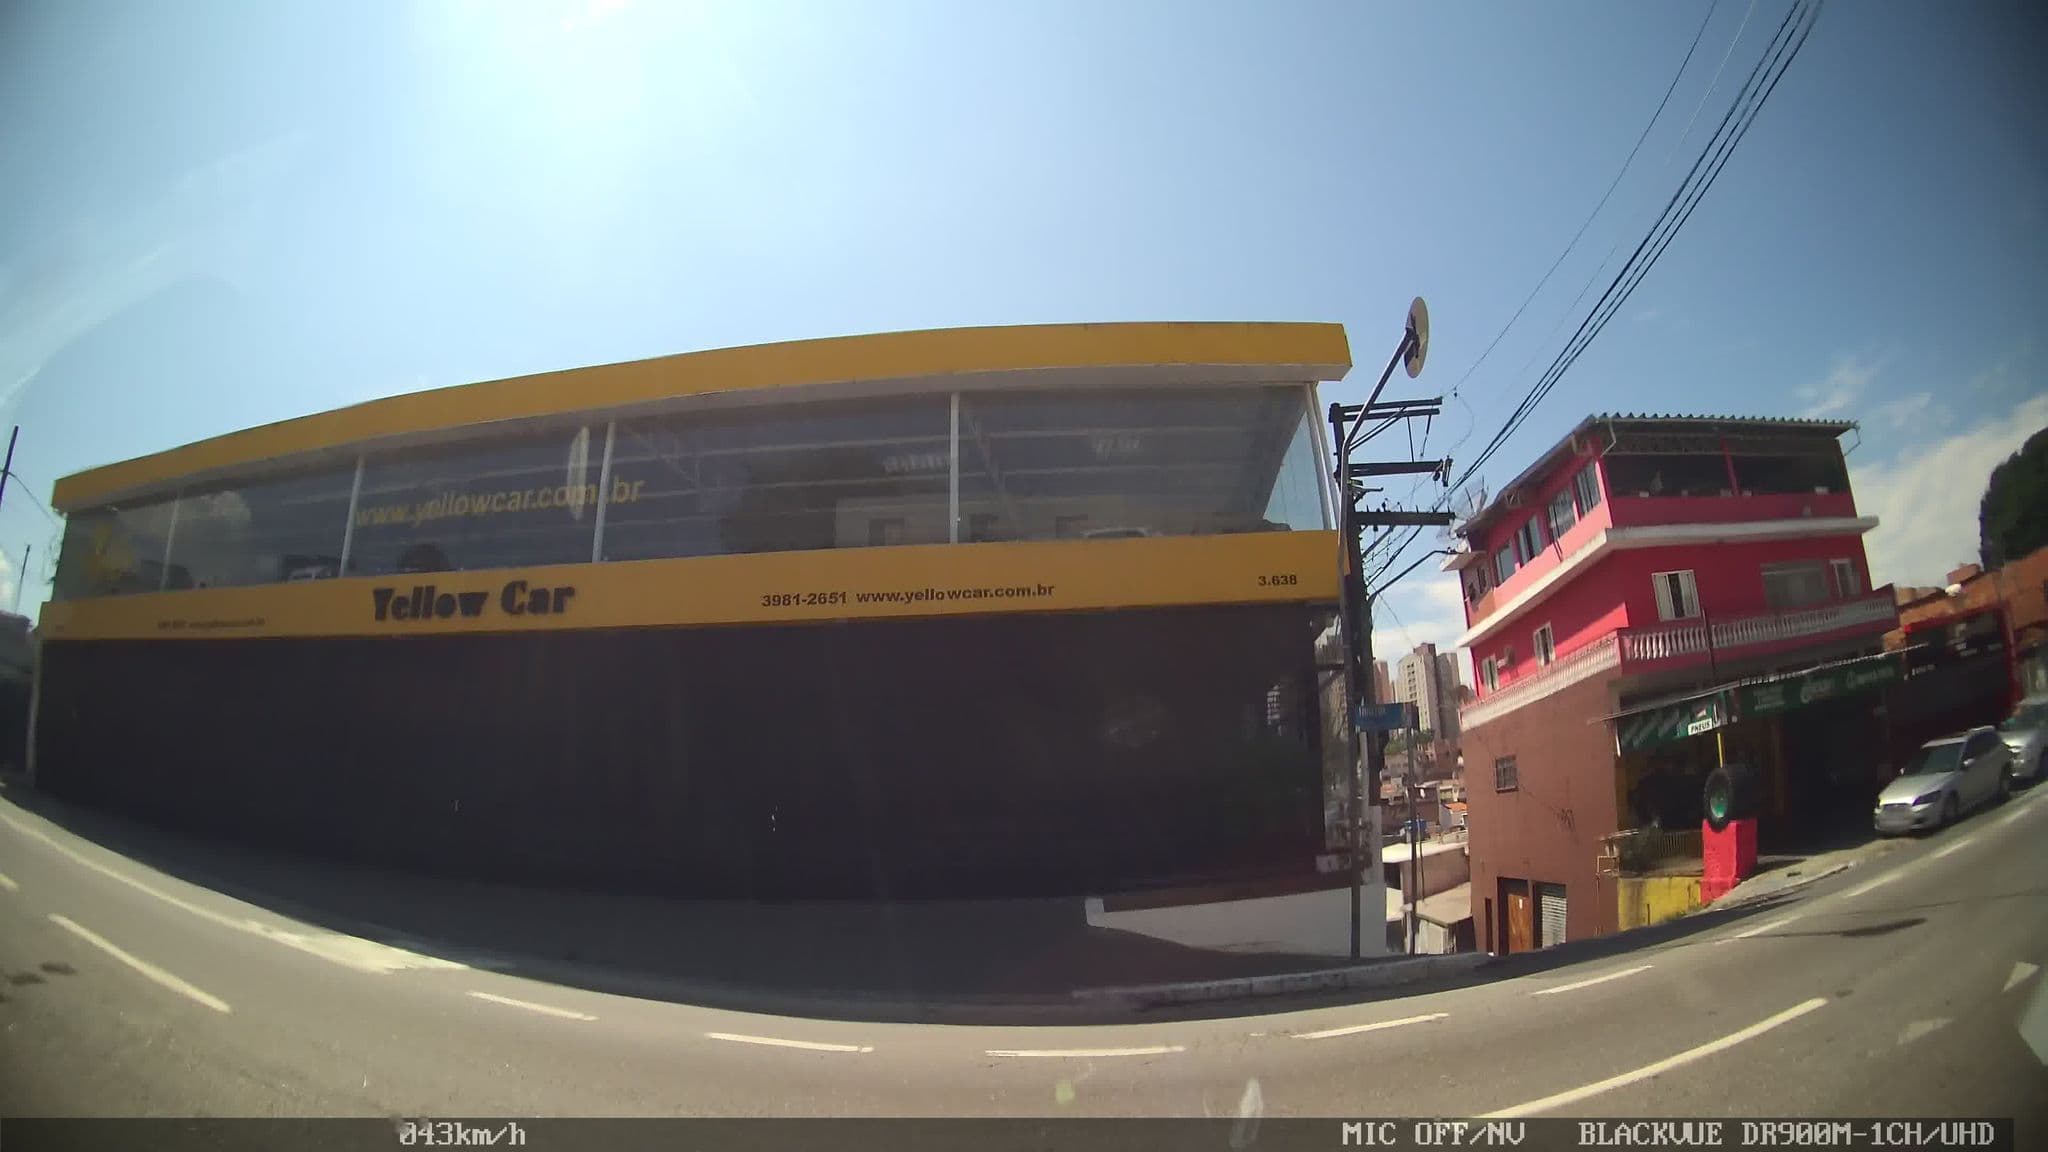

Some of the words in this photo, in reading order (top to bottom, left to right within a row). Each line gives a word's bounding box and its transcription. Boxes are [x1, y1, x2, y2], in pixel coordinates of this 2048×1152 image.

[1258, 574, 1297, 586] 3.638
[373, 585, 489, 622] Yellow
[501, 580, 576, 615] Car
[761, 591, 848, 607] 3981-2651
[856, 583, 1055, 604] www.yellowcar.com.br
